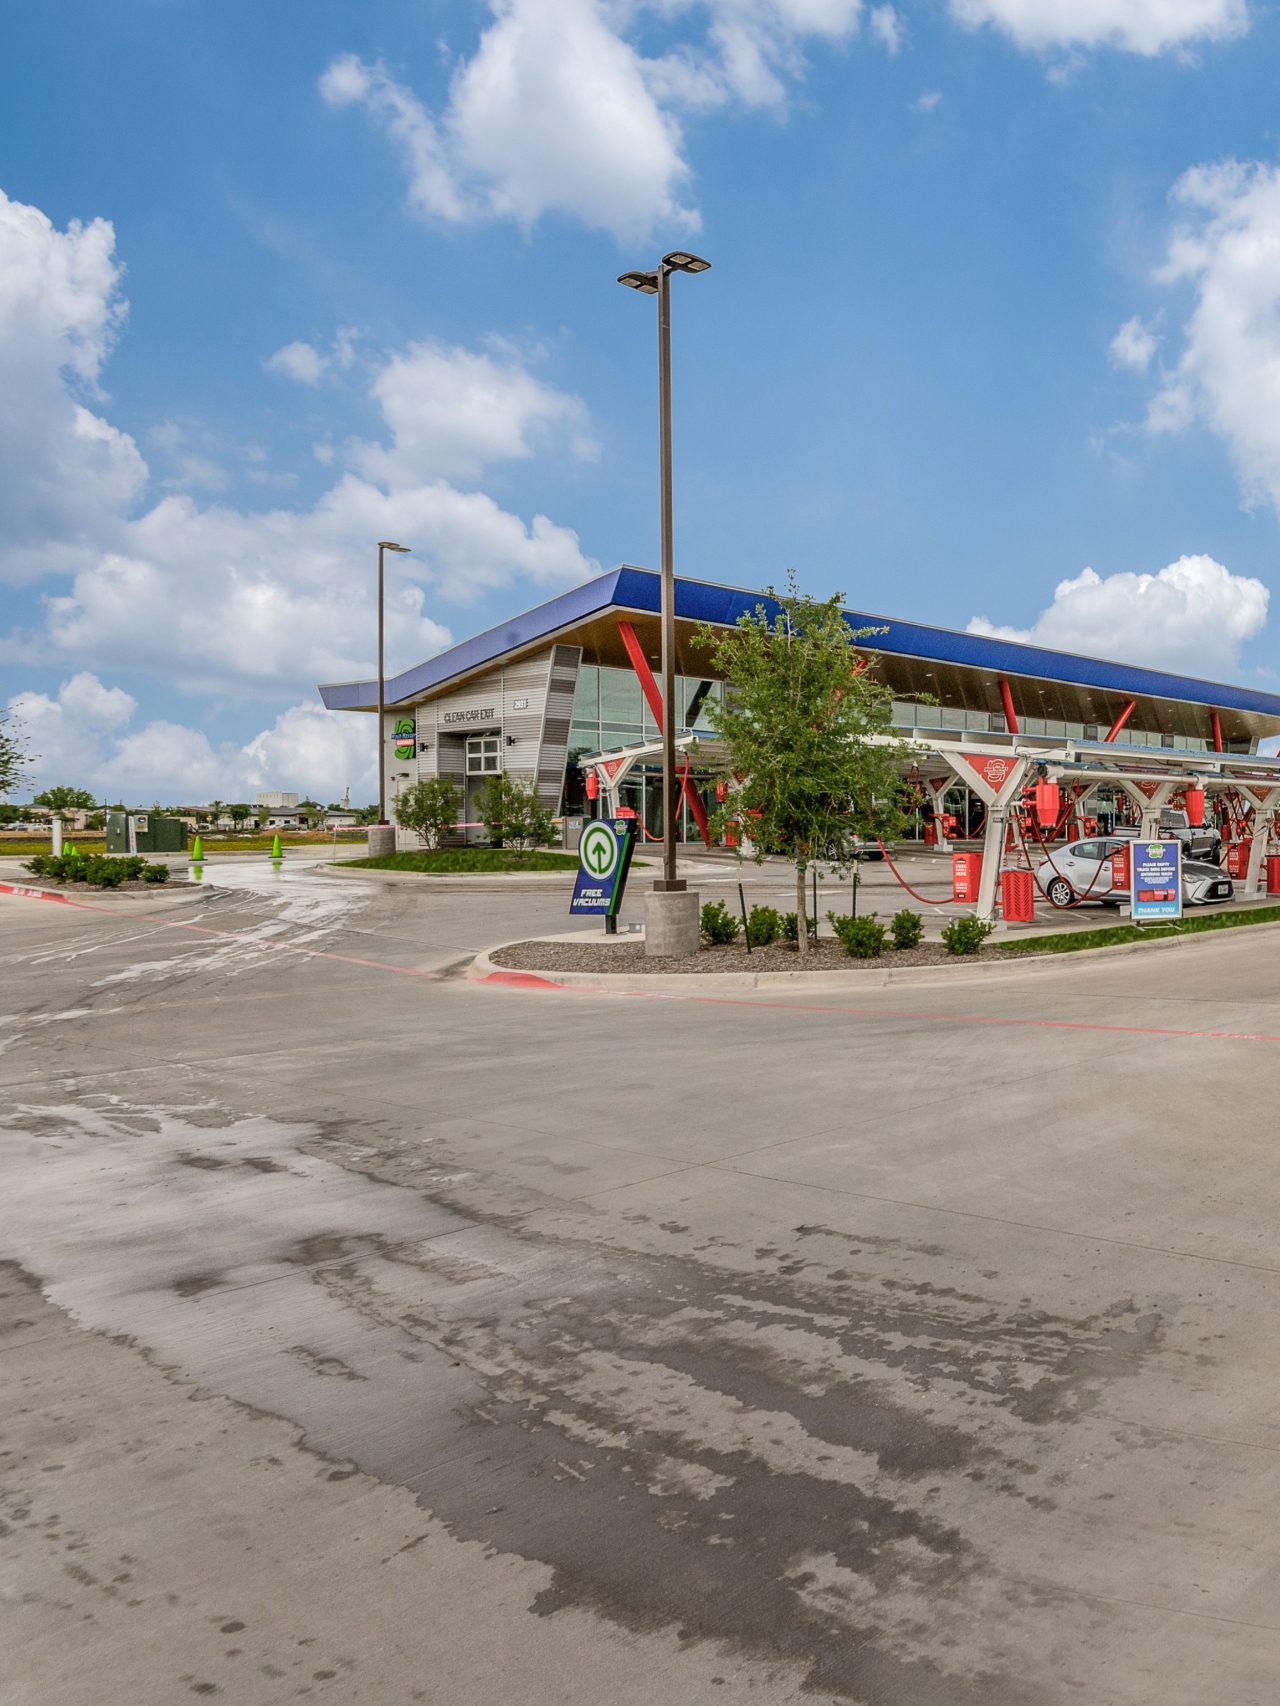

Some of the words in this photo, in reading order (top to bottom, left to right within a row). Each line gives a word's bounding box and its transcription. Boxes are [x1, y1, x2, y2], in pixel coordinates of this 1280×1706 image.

[444, 711, 464, 723] CLEAN
[466, 710, 480, 721] CAR
[480, 708, 495, 720] EXIT
[581, 889, 603, 897] FREE
[573, 898, 611, 906] VACUUMS
